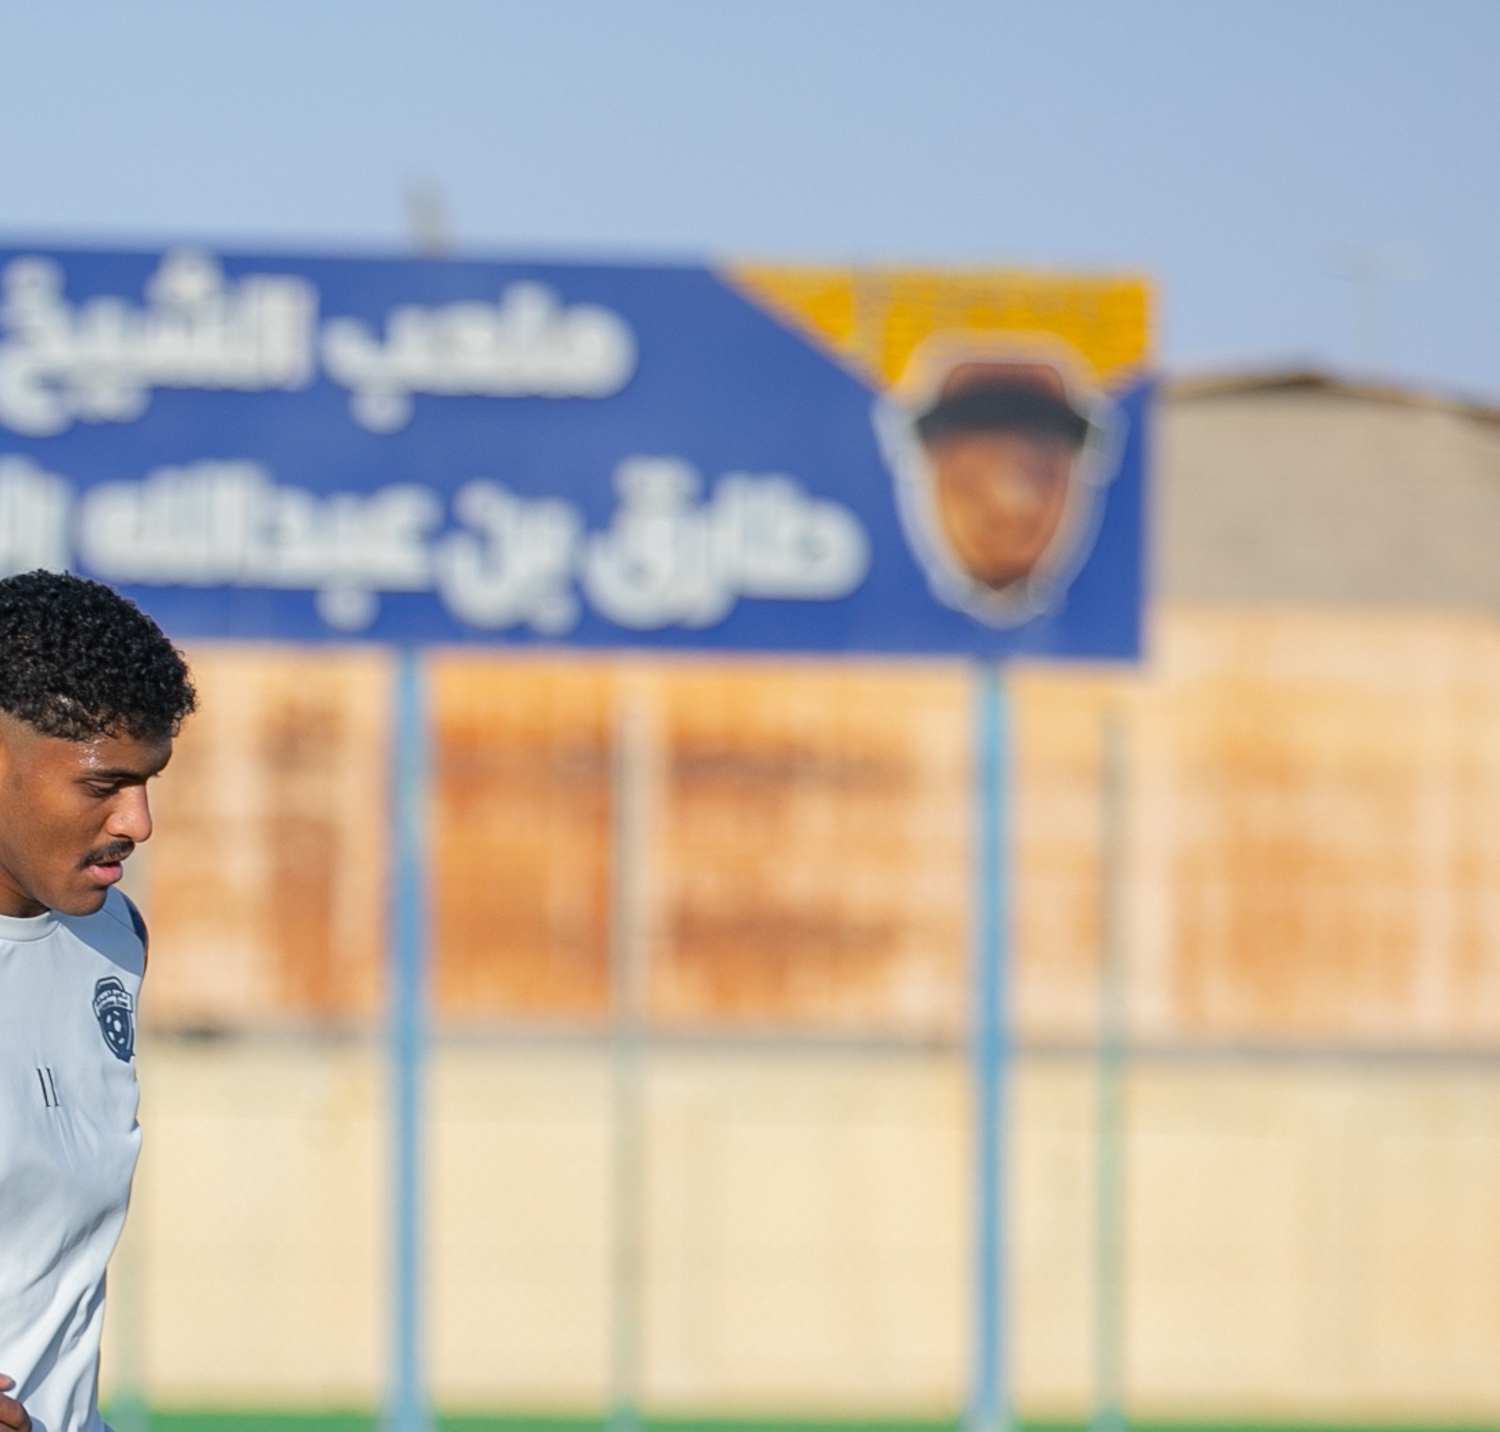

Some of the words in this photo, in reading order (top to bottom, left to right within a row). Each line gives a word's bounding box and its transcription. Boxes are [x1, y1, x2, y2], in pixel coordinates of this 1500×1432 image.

[322, 279, 636, 432] ملعب
[82, 459, 444, 632] عبدالله
[436, 481, 583, 636] بن
[582, 455, 870, 630] طارق
